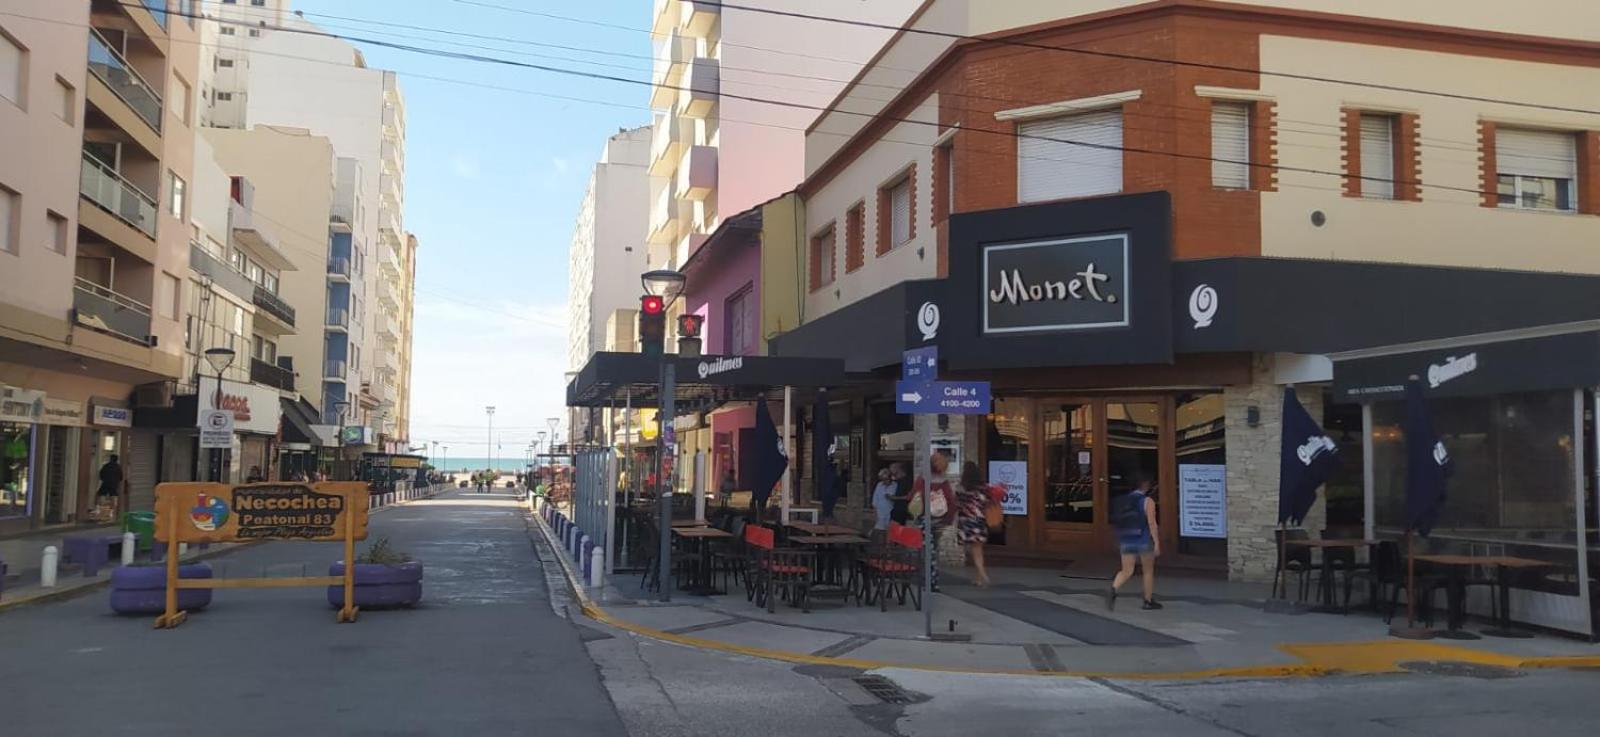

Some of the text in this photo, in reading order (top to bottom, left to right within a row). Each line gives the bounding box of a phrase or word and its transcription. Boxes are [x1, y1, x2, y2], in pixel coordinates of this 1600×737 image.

[698, 357, 742, 379] Quilmes
[944, 387, 976, 396] Calle 4
[940, 400, 980, 408] 4100-4200
[236, 495, 341, 510] Necochea
[1002, 492, 1021, 504] 0%
[243, 514, 331, 525] Peatonal 83
